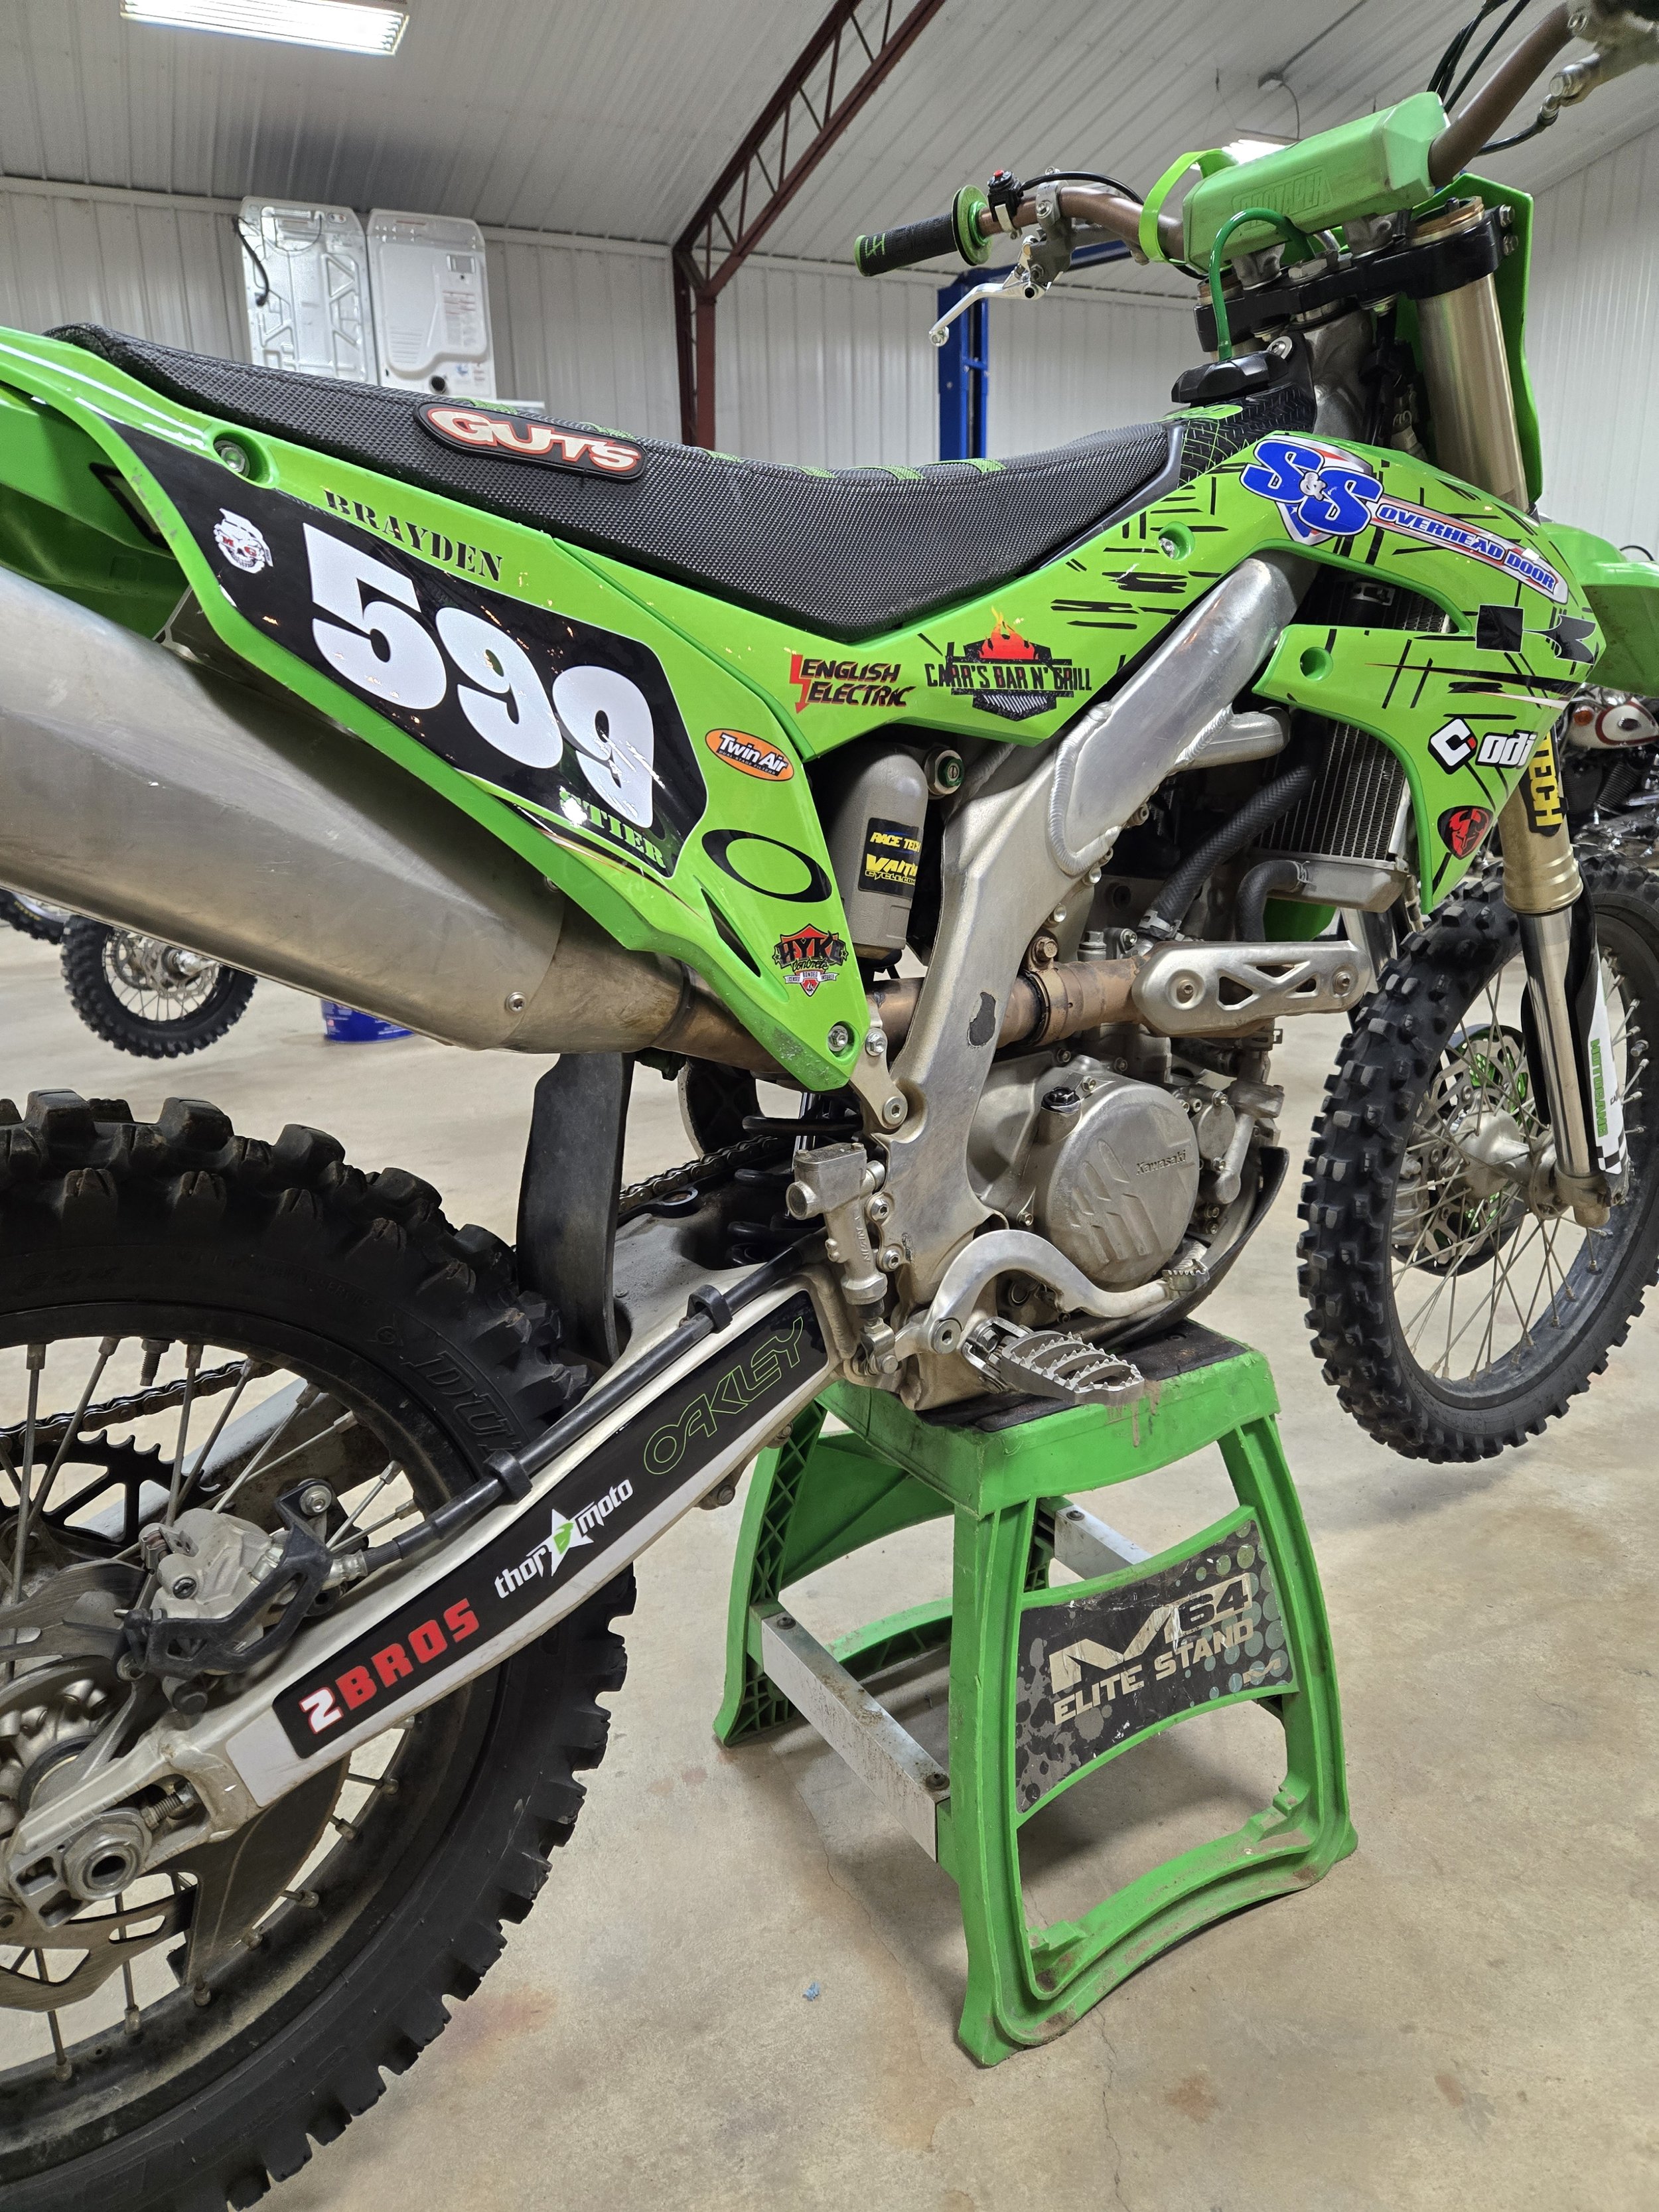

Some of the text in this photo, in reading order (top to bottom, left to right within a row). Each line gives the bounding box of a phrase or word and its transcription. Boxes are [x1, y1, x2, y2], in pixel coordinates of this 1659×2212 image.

[428, 407, 641, 471] GUTS
[323, 490, 503, 582] BRAYDEN
[1240, 439, 1557, 592] S&S OVERHEAD DOOR
[303, 522, 654, 828] 599
[800, 658, 901, 683] ENGLISH
[806, 681, 916, 707] ELECTRIC
[924, 663, 1092, 691] CARR'S BAR N' GRILL
[720, 734, 788, 773] Twin Air
[869, 832, 903, 848] RACE
[1136, 1149, 1187, 1175] Kawasaki
[644, 1316, 804, 1475] OAKLEY
[494, 1479, 634, 1599] thor moto
[1053, 1617, 1255, 1726] ELITE STAND
